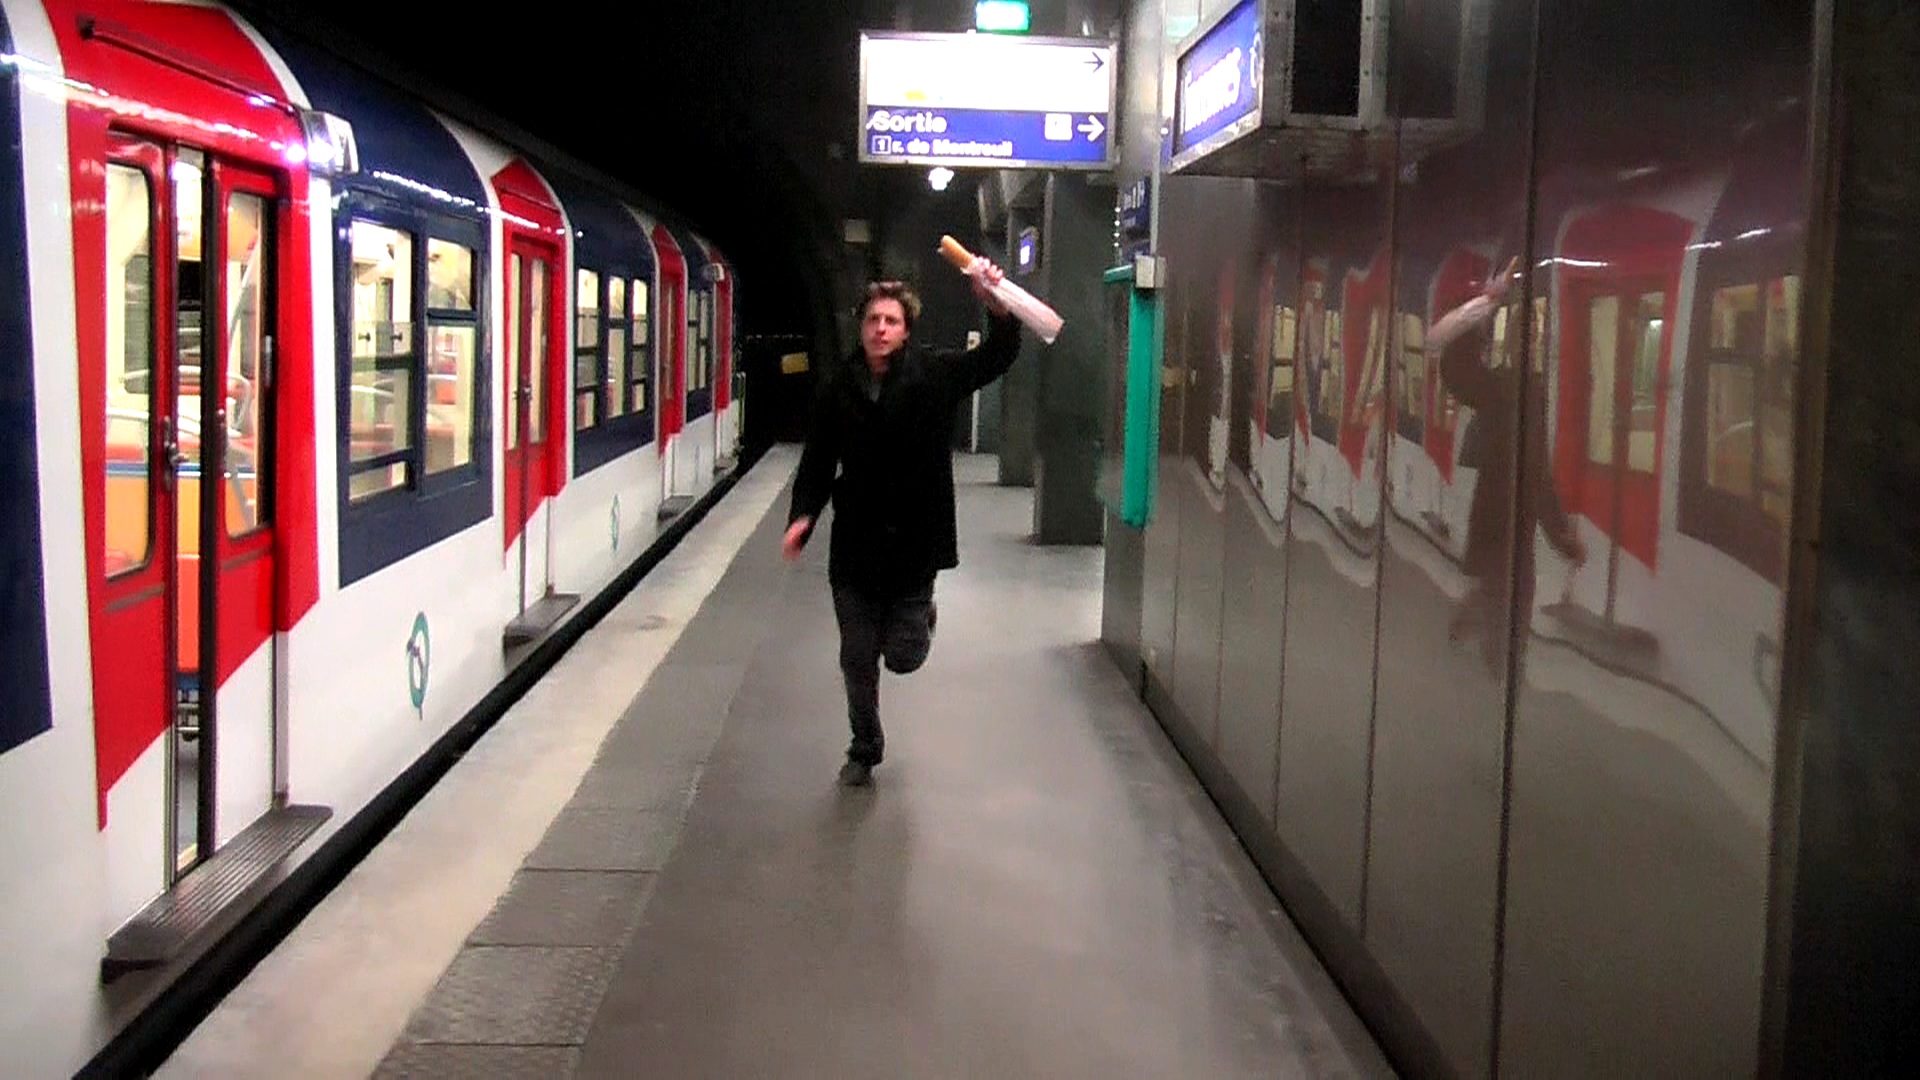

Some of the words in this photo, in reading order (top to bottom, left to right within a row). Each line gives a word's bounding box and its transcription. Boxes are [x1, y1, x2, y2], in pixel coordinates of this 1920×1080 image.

[868, 110, 947, 133] Sortie
[907, 138, 930, 154] de
[932, 139, 1013, 157] Montreuil
